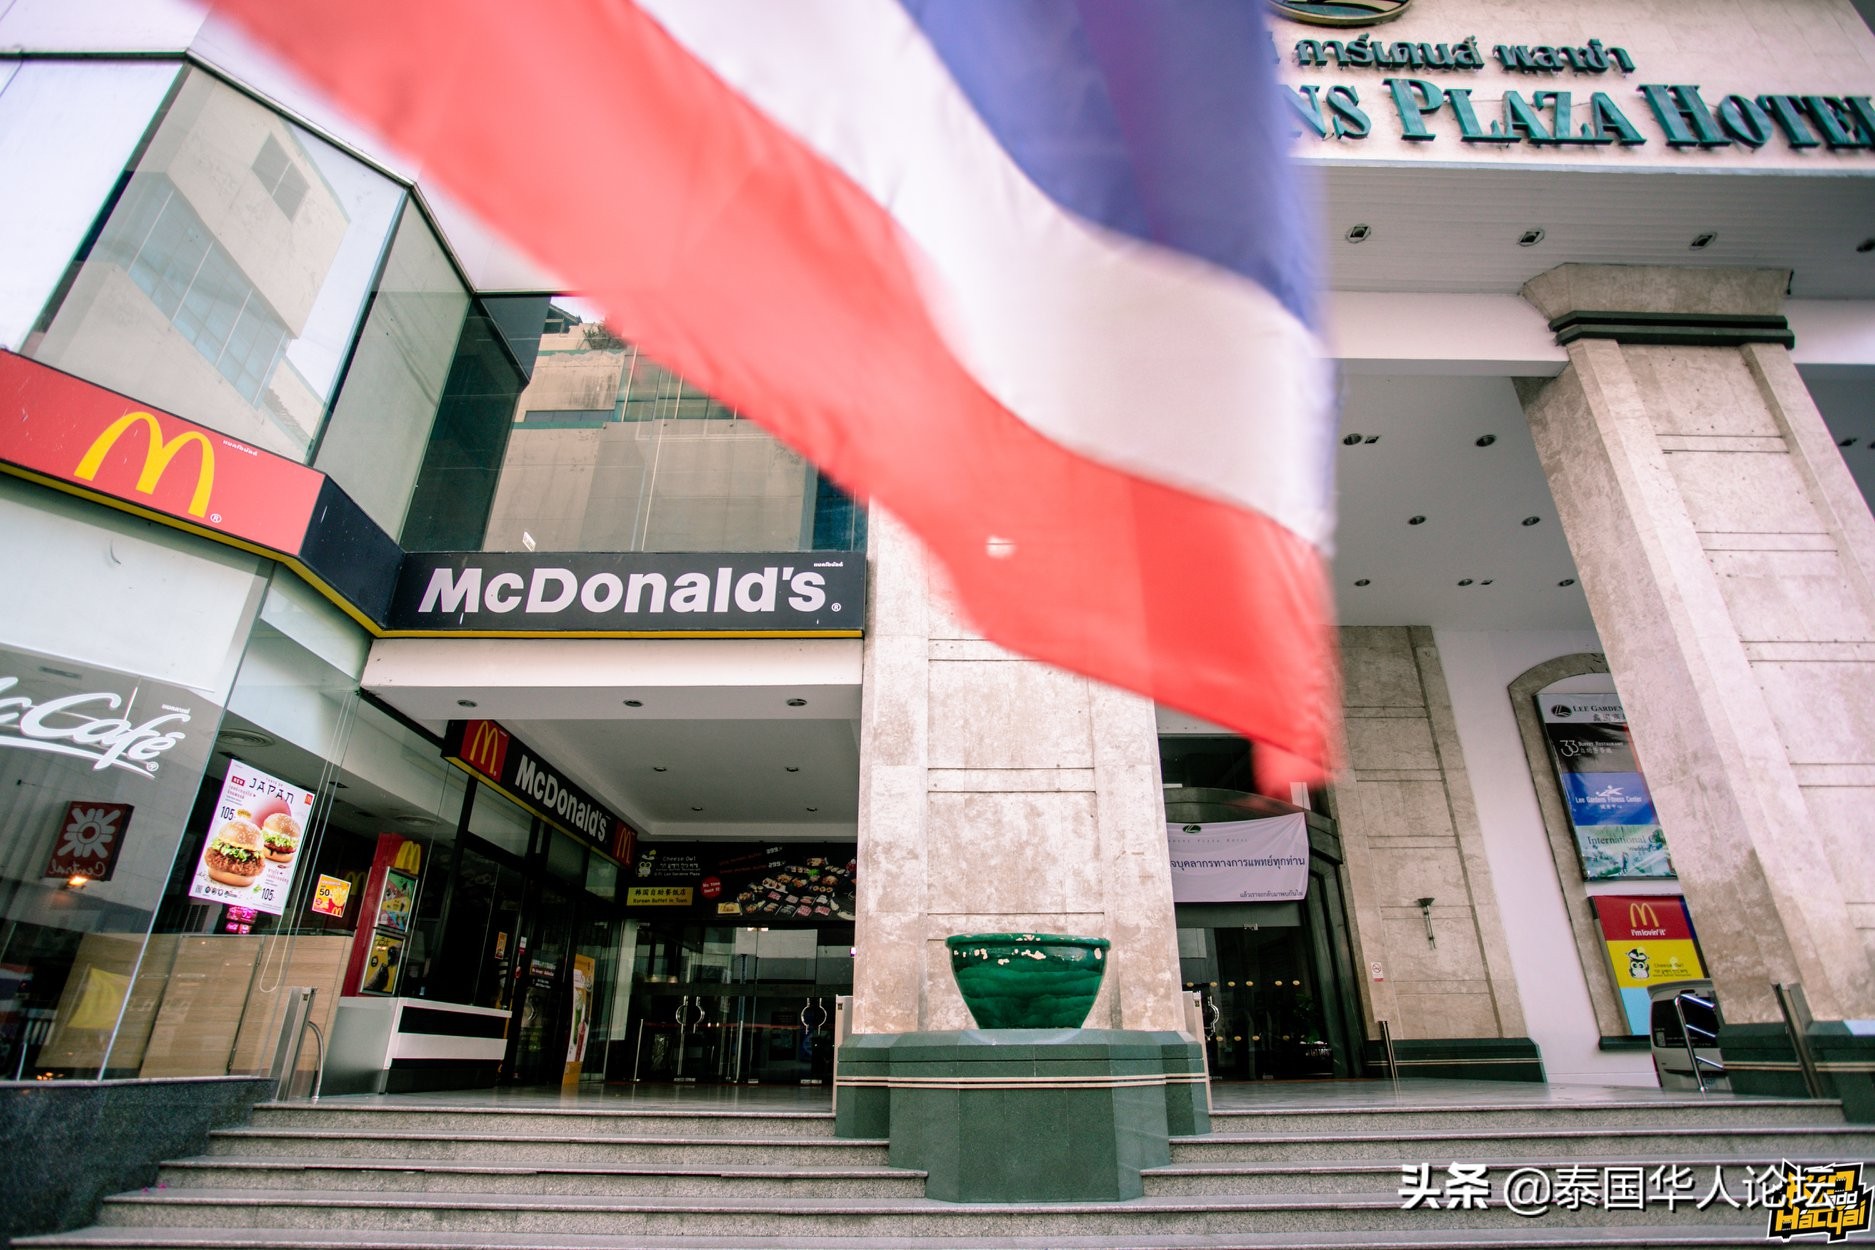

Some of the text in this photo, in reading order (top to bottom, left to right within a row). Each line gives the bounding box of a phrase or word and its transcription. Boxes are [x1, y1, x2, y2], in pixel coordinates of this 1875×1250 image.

[1294, 32, 1636, 74] การ์เดนส์ พลาซ่า
[1382, 77, 1646, 147] PLAZA
[418, 566, 827, 614] McDonald's
[1559, 740, 1579, 757] 33
[249, 778, 295, 804] JAPAN
[514, 754, 607, 842] McDonald's
[1587, 835, 1646, 845] International
[1170, 855, 1305, 871] จบุคลากรทางการแพทย์ทุกท่าน
